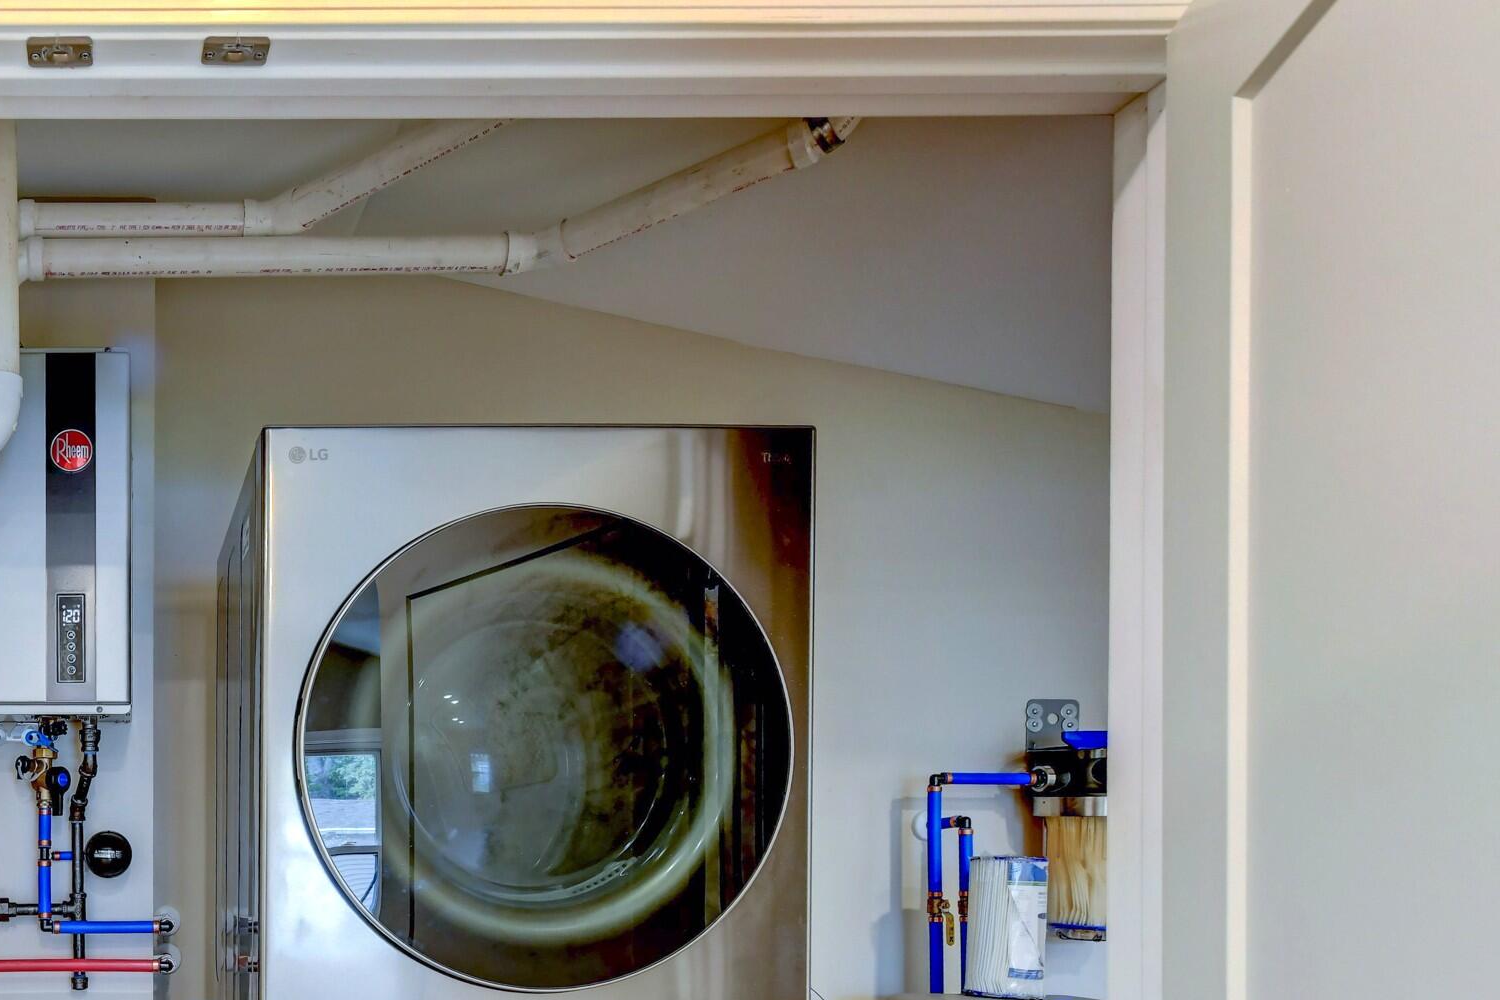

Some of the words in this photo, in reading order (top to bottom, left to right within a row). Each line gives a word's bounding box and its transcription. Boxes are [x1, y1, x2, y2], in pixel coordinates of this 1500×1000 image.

[56, 432, 89, 463] Rheem
[309, 448, 329, 461] LG
[62, 609, 80, 623] 120
